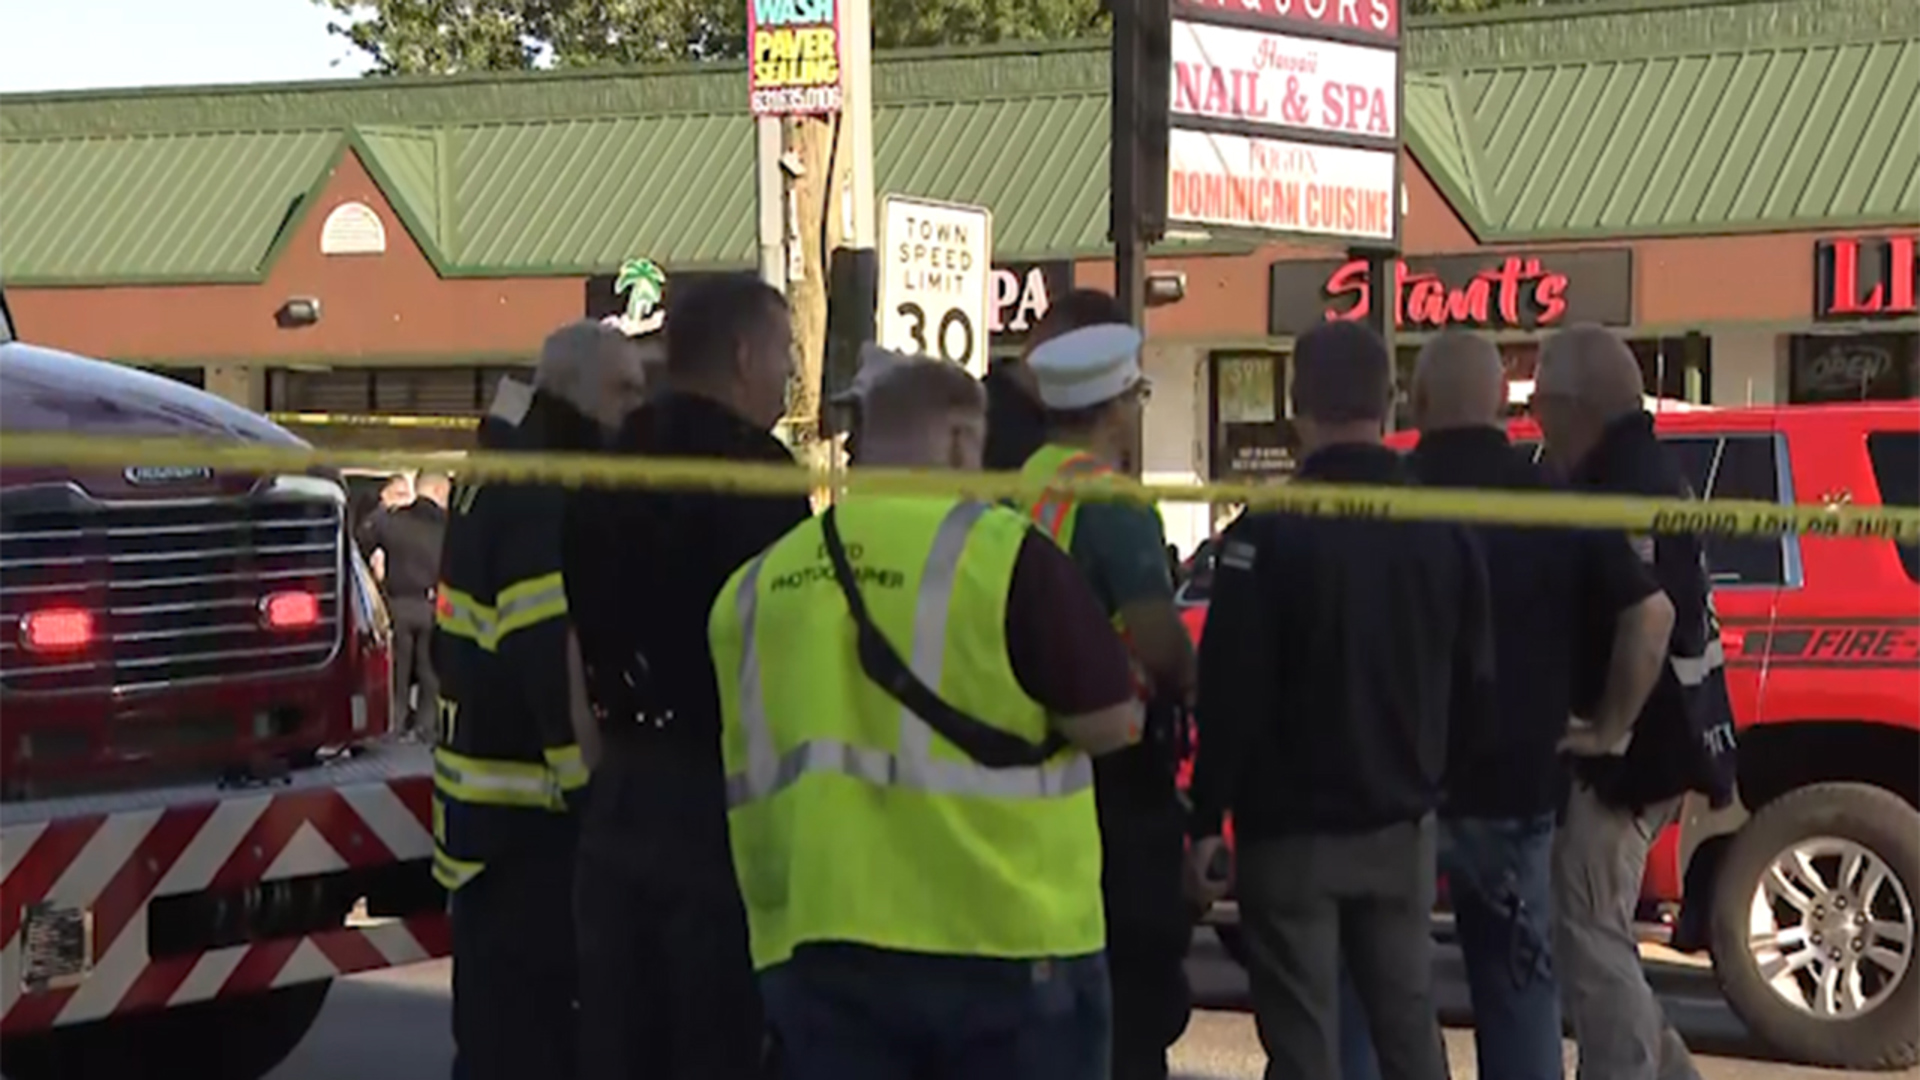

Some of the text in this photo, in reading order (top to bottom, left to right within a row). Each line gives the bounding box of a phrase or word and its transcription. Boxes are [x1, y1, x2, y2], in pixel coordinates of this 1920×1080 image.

[754, 0, 834, 25] WASH
[754, 28, 837, 61] PAVER
[754, 58, 840, 86] SEALING
[1174, 61, 1391, 134] NAIL & SPA
[1172, 171, 1388, 233] DOMINICAN CUISINE
[906, 218, 968, 245] TOWN
[899, 245, 973, 271] SPEED
[904, 271, 964, 293] LIMIT
[895, 301, 974, 369] 30
